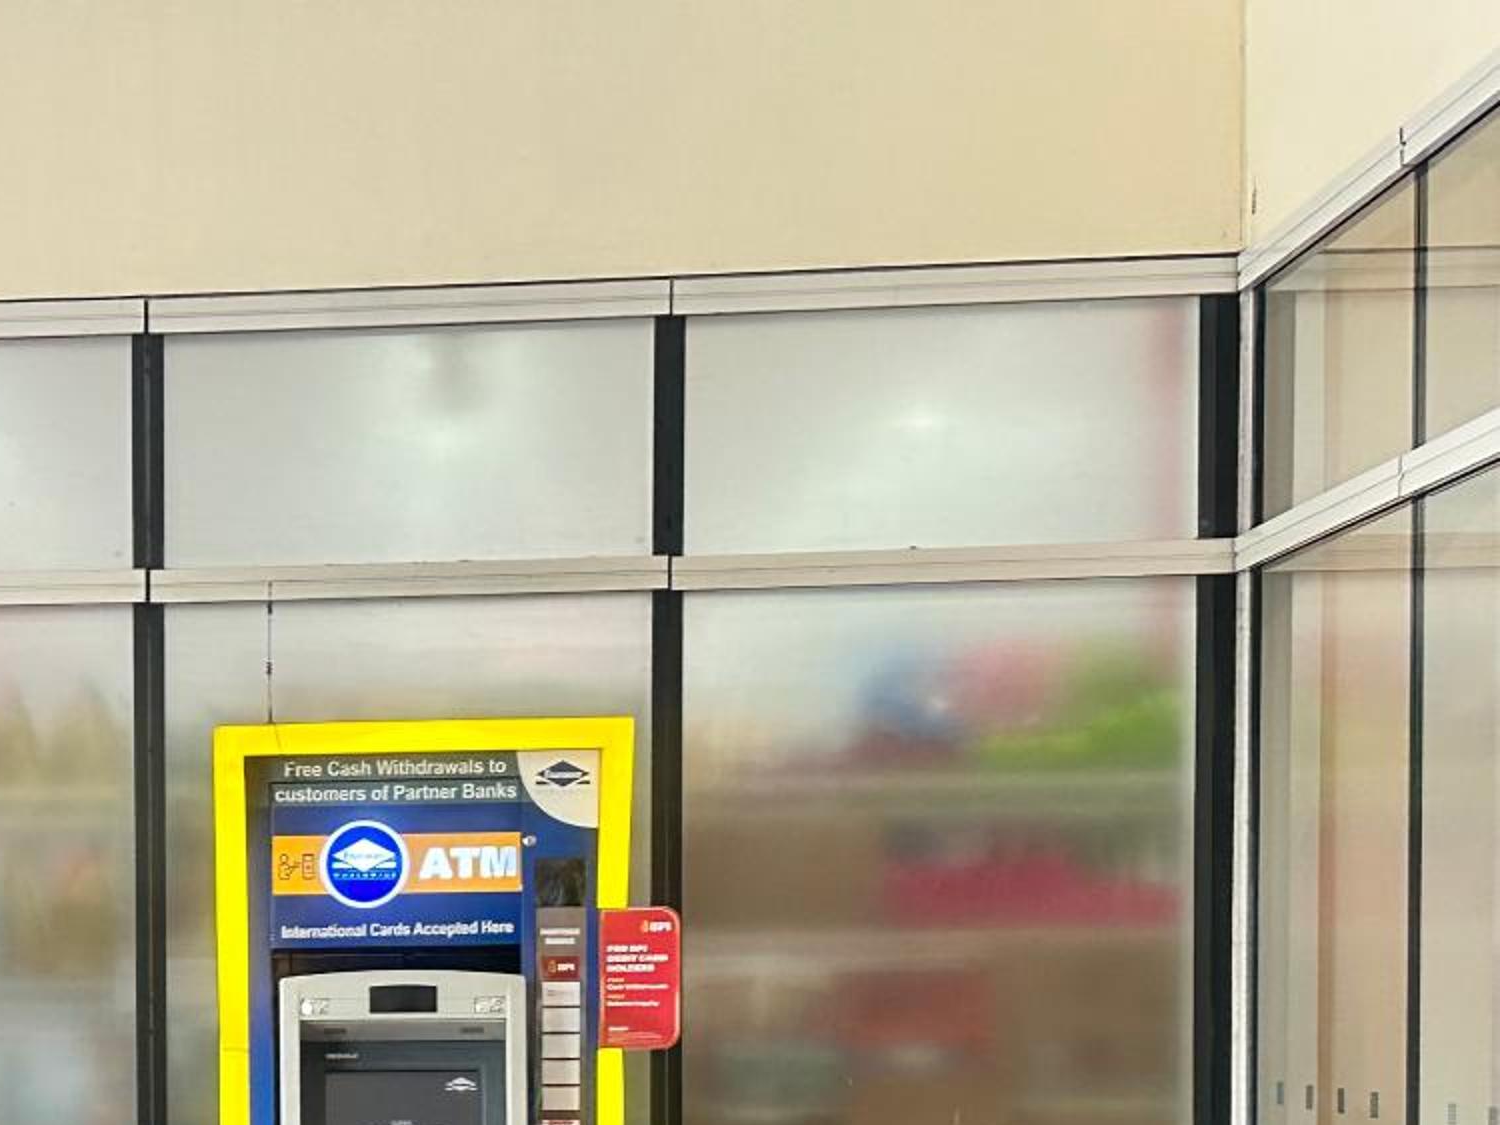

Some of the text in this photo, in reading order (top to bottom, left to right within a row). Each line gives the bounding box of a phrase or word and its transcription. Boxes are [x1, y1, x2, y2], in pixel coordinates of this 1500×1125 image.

[284, 759, 507, 777] Free Cash Withdrawals to
[275, 783, 517, 802] customers of Partner Banks
[418, 845, 517, 880] ATM
[281, 920, 514, 939] International Cards Accepted Here
